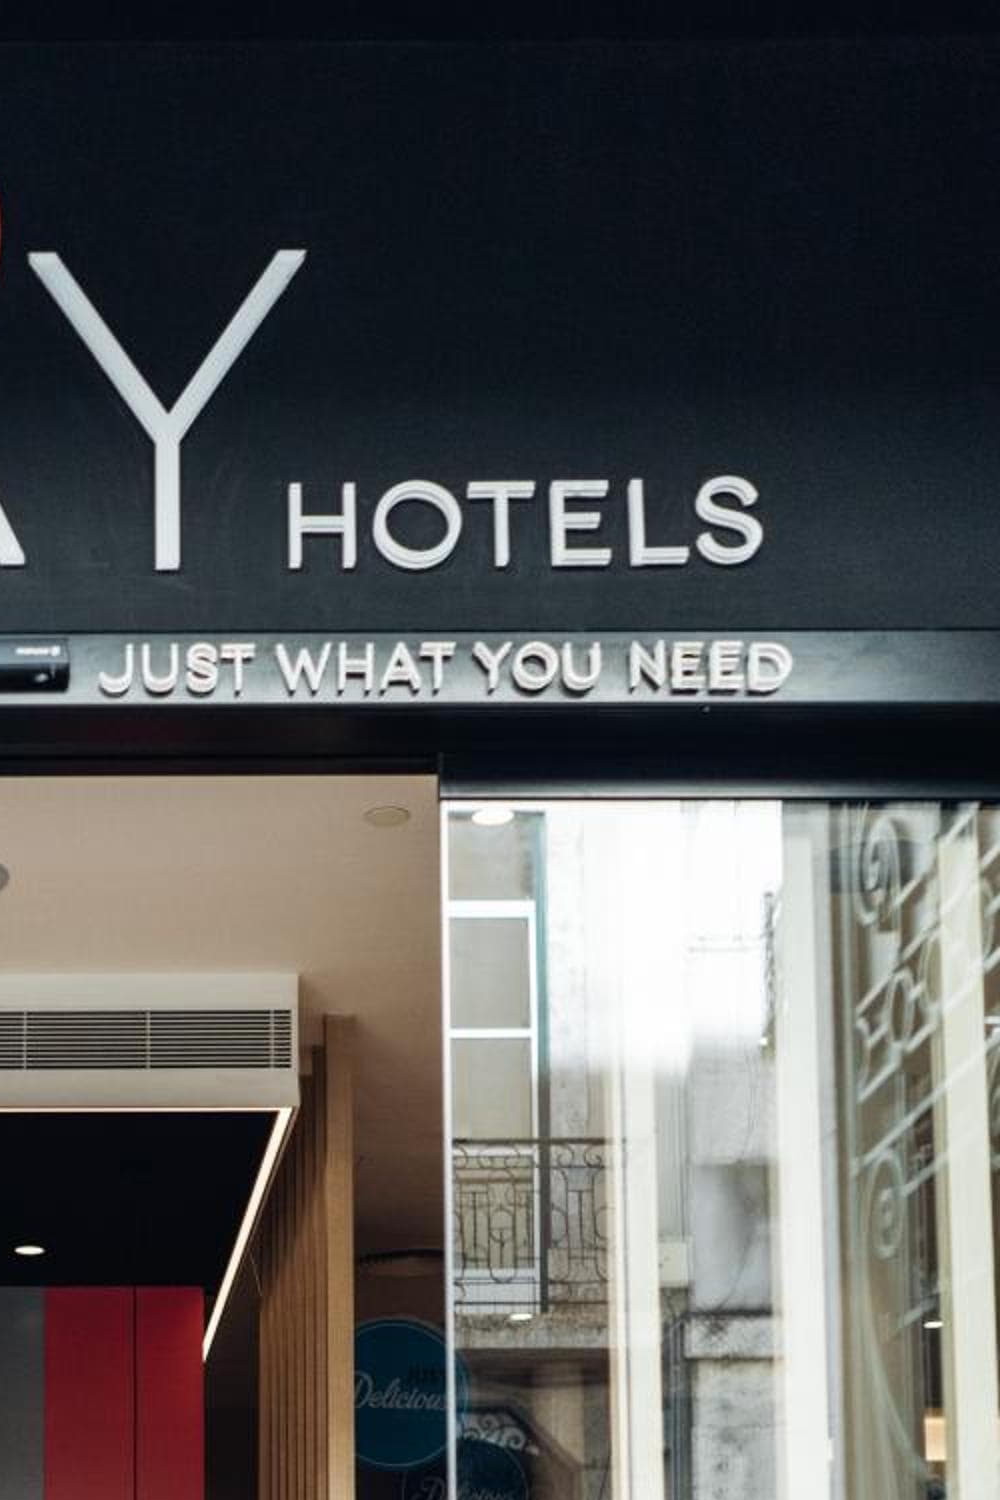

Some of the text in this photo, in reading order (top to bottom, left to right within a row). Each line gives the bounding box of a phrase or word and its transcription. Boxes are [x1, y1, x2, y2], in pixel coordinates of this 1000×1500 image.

[287, 474, 764, 570] HOTELS
[99, 639, 794, 695] JUST WHAT YOU NEED
